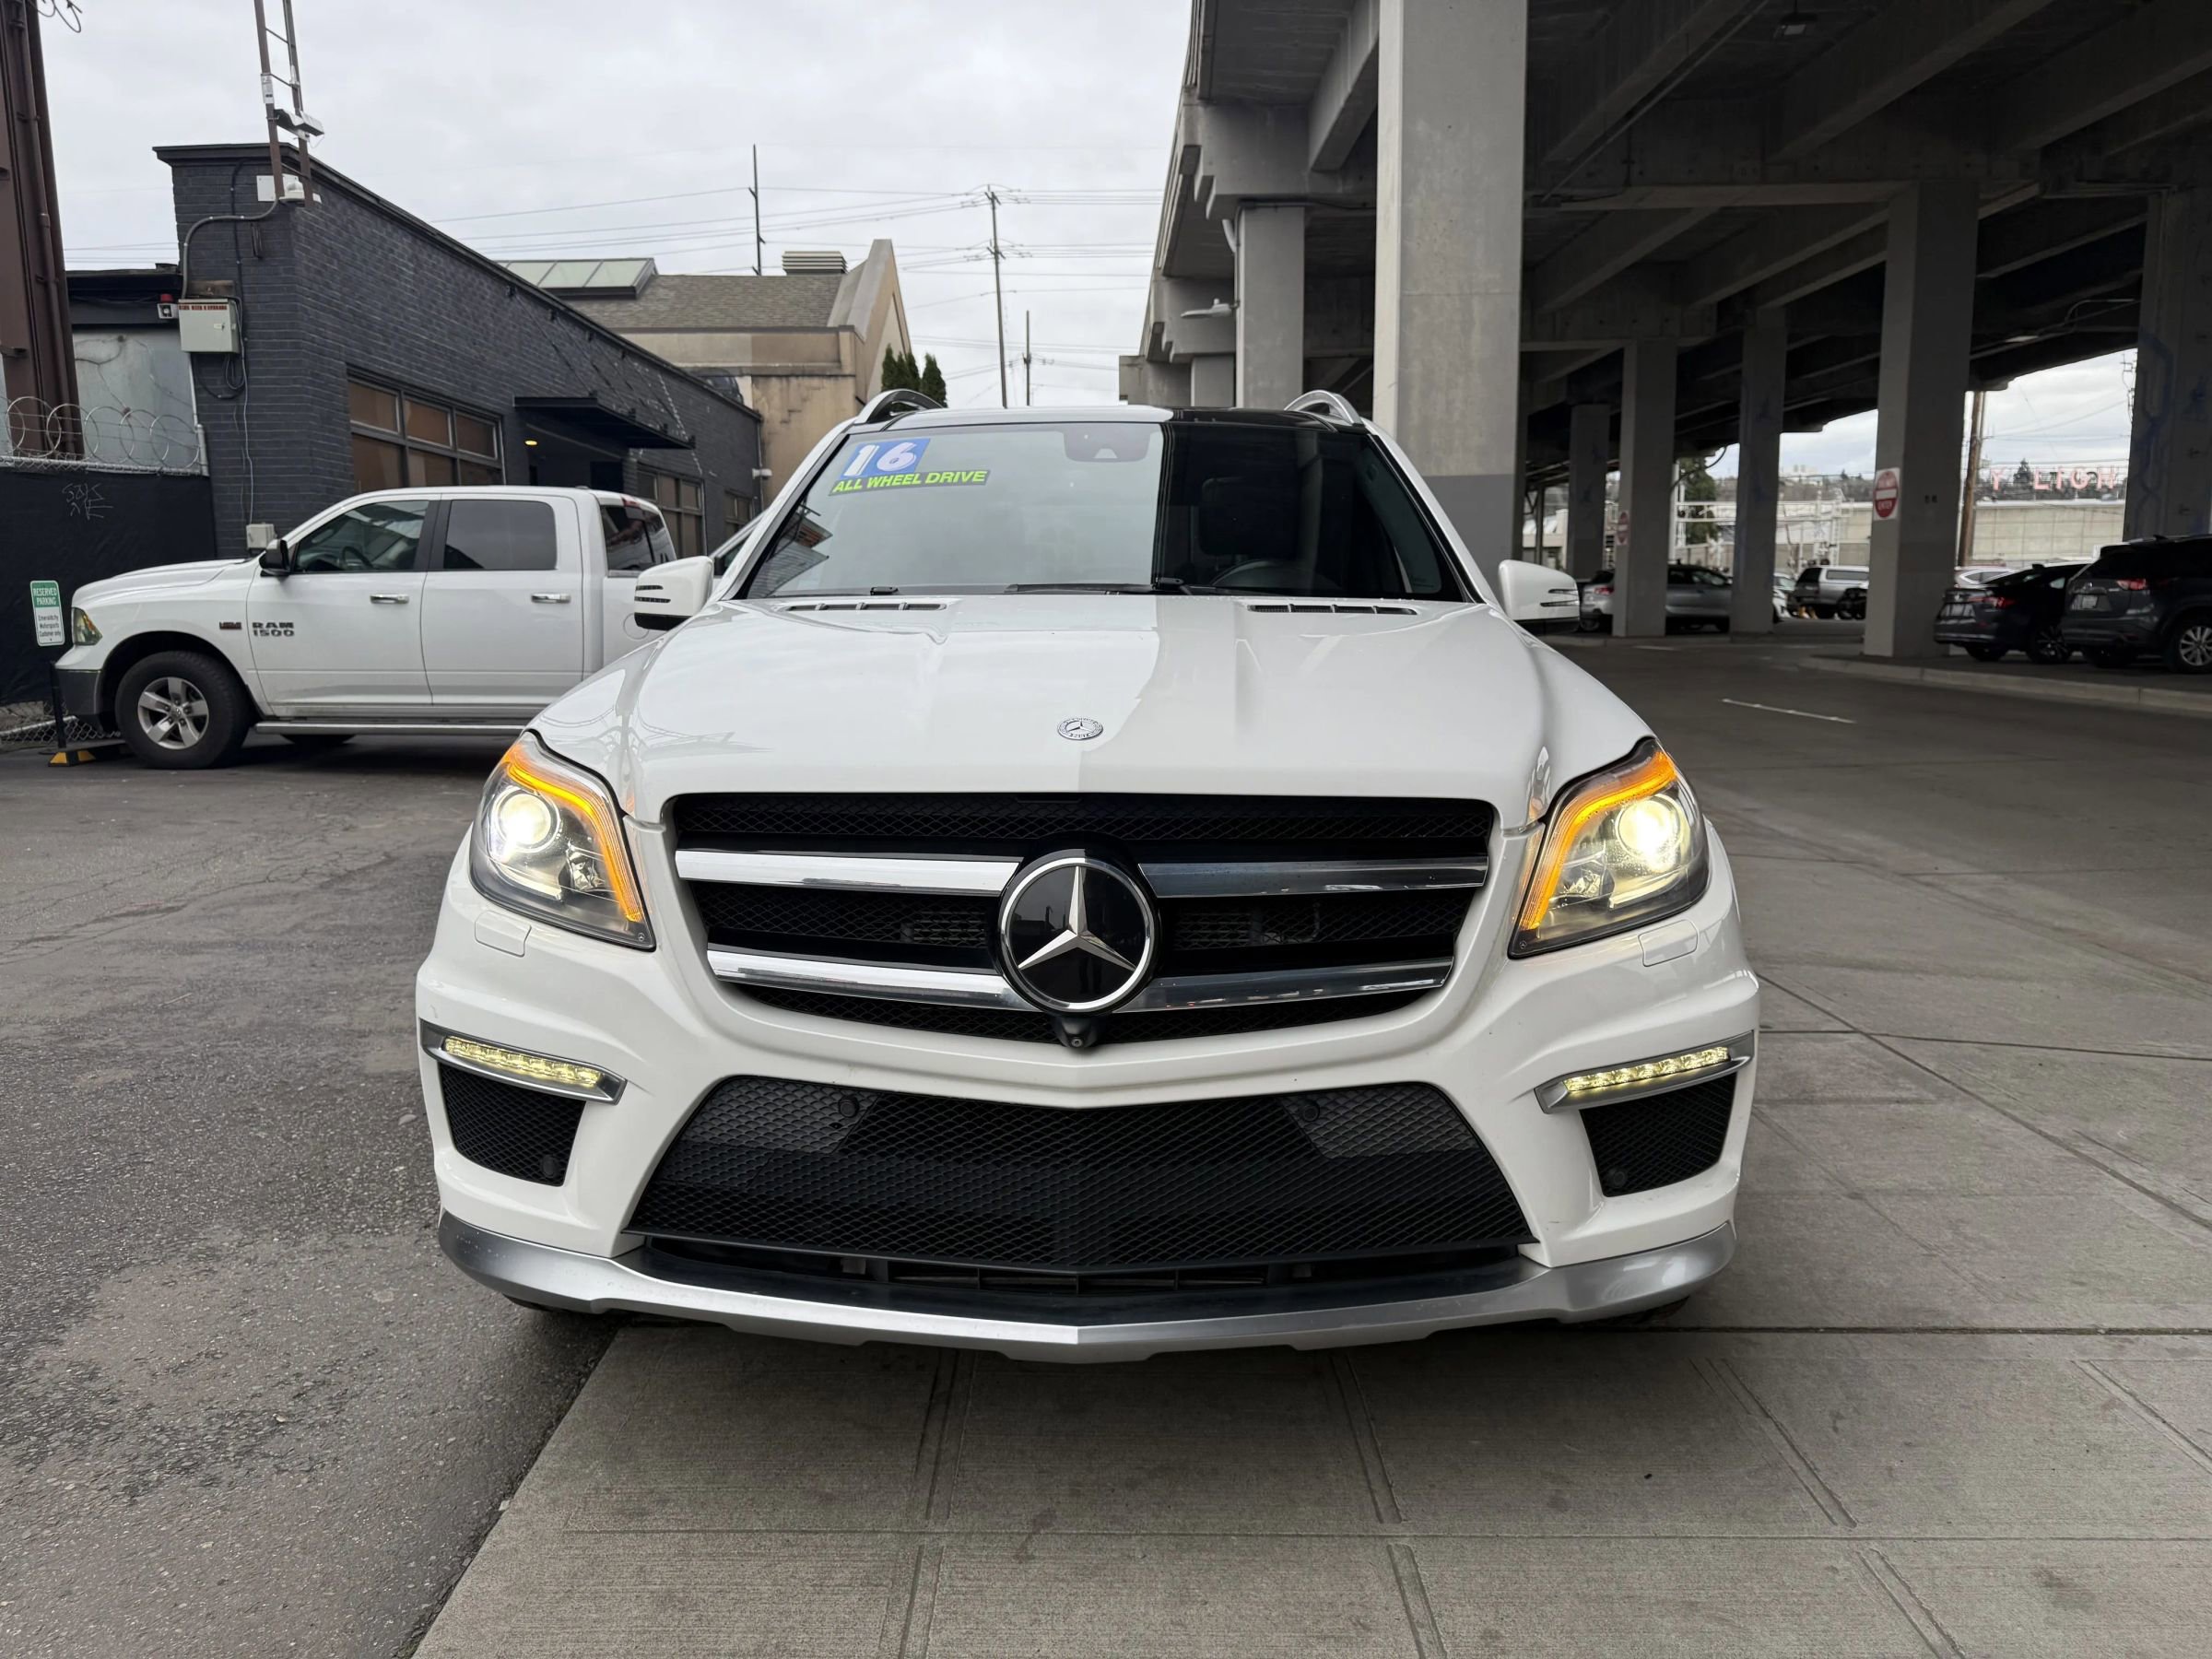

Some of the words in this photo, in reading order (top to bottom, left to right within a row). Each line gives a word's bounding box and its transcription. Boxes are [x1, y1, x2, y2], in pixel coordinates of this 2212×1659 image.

[843, 442, 917, 477] 16
[832, 478, 863, 493] ALL
[867, 473, 921, 488] WHEEL
[924, 471, 988, 484] DRIVE
[33, 587, 57, 597] RESERVED
[37, 596, 57, 606] PARKING
